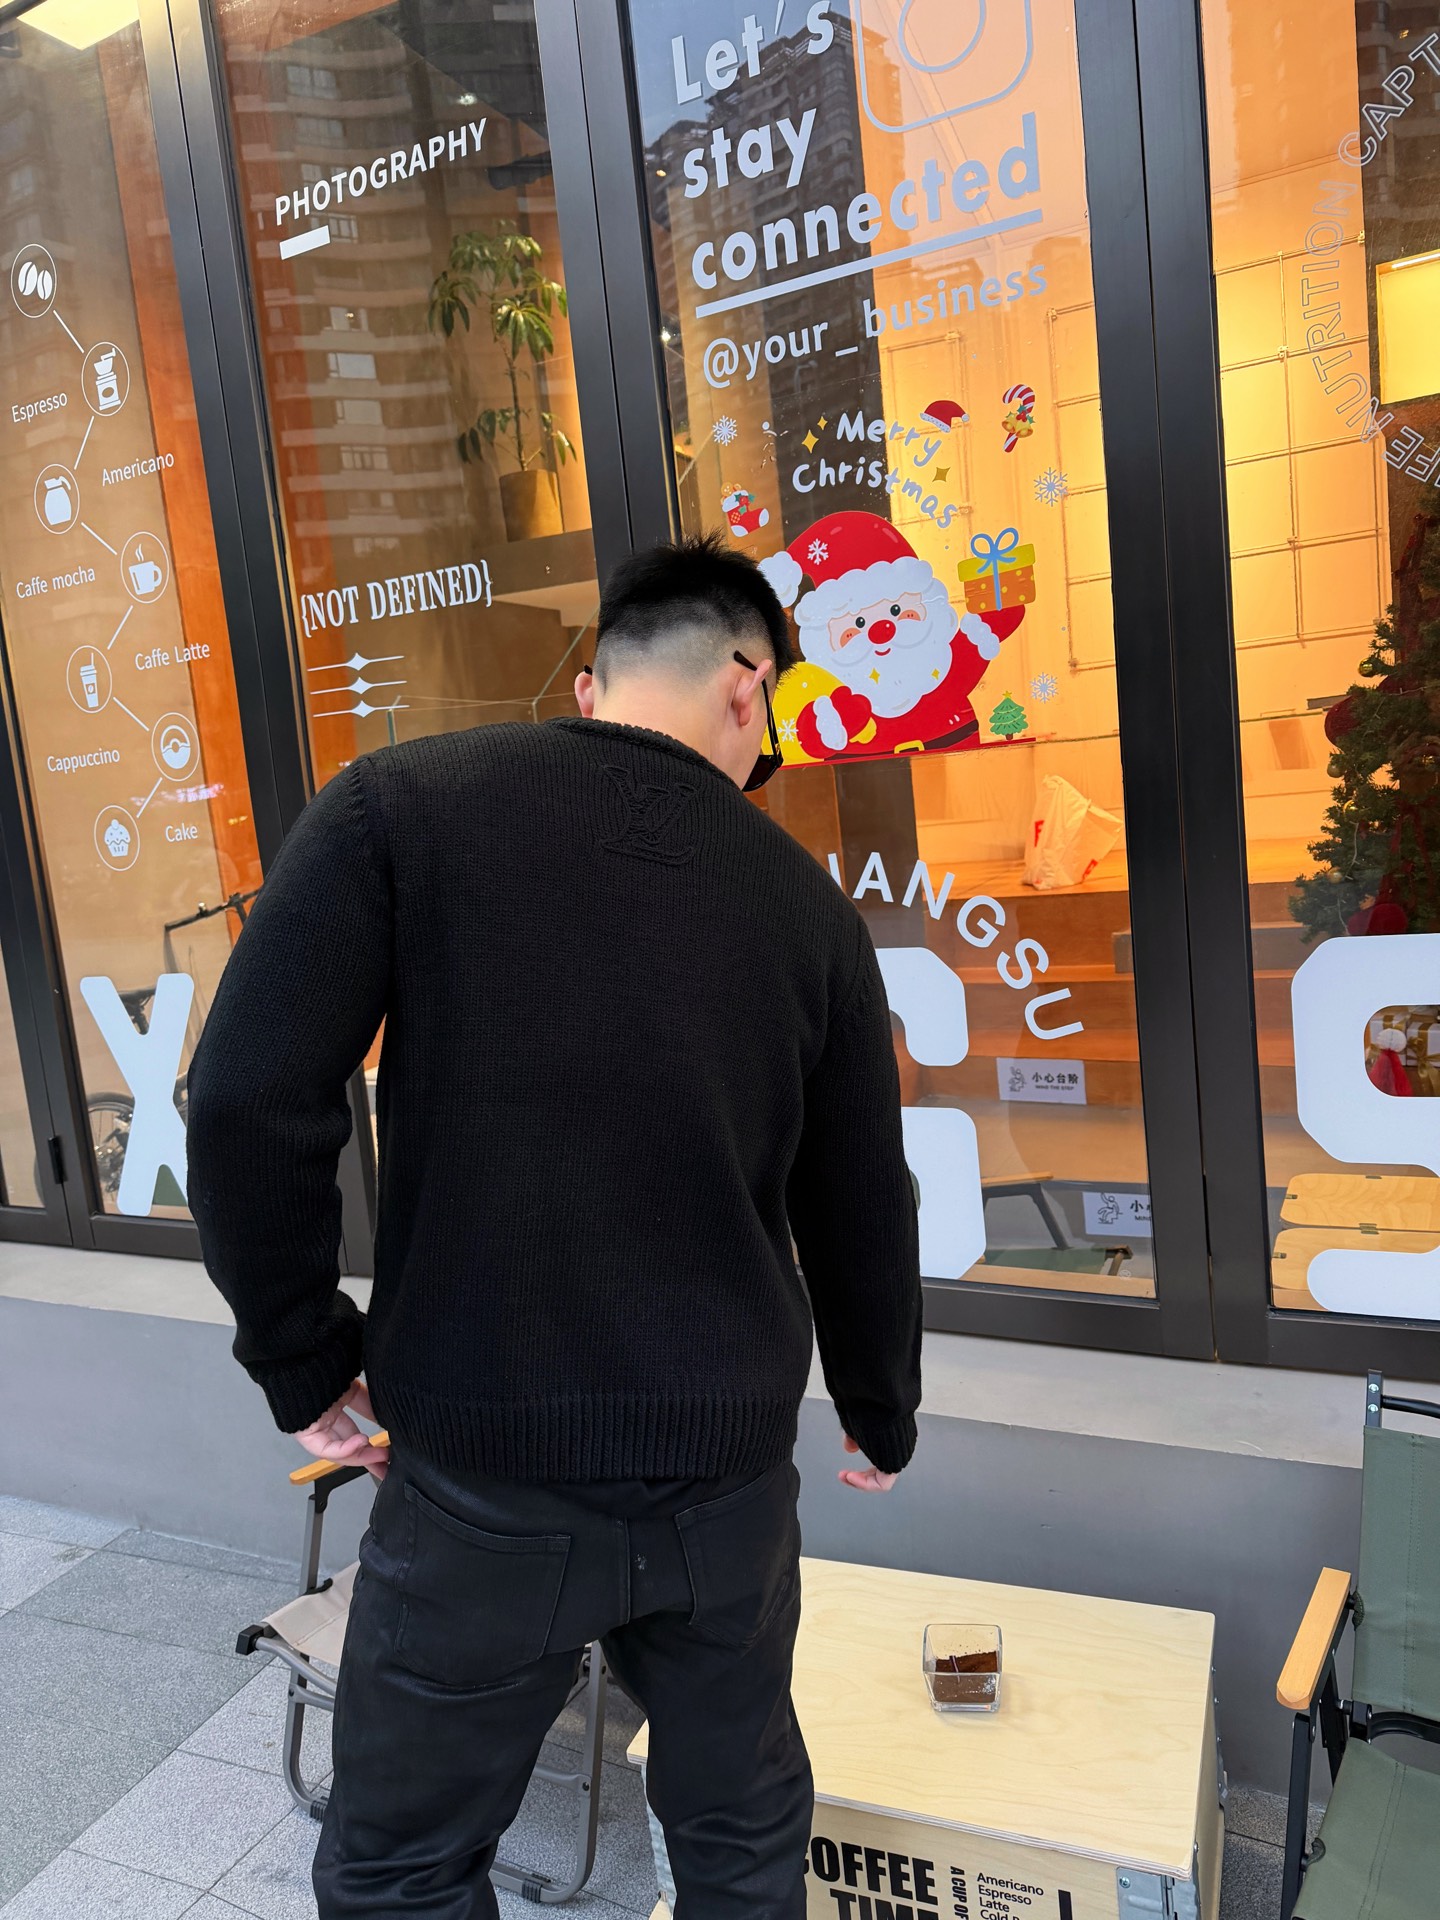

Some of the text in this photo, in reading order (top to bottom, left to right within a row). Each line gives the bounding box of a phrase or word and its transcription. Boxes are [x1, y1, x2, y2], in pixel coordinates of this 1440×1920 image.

[671, 0, 835, 105] Let's
[683, 107, 818, 199] stay
[274, 118, 489, 226] PHOTOGRAPHY
[691, 111, 1041, 290] connected
[1301, 180, 1395, 443] NUTRITION
[11, 392, 68, 423] Espresso
[836, 410, 943, 468] Merry
[102, 453, 175, 487] Americano
[792, 456, 959, 529] Christmas
[16, 565, 96, 599] Caffe mocha
[135, 642, 211, 671] Caffe Latte
[47, 748, 121, 774] Cappuccino
[165, 823, 199, 843] Cake
[1032, 1071, 1079, 1084] 小心台阶
[804, 1836, 938, 1906] OFFEE
[950, 1866, 965, 1876] A
[977, 1872, 1044, 1896] Americano
[951, 1877, 967, 1903] CUP
[978, 1885, 1032, 1906] Espresso
[979, 1896, 1010, 1913] Latte
